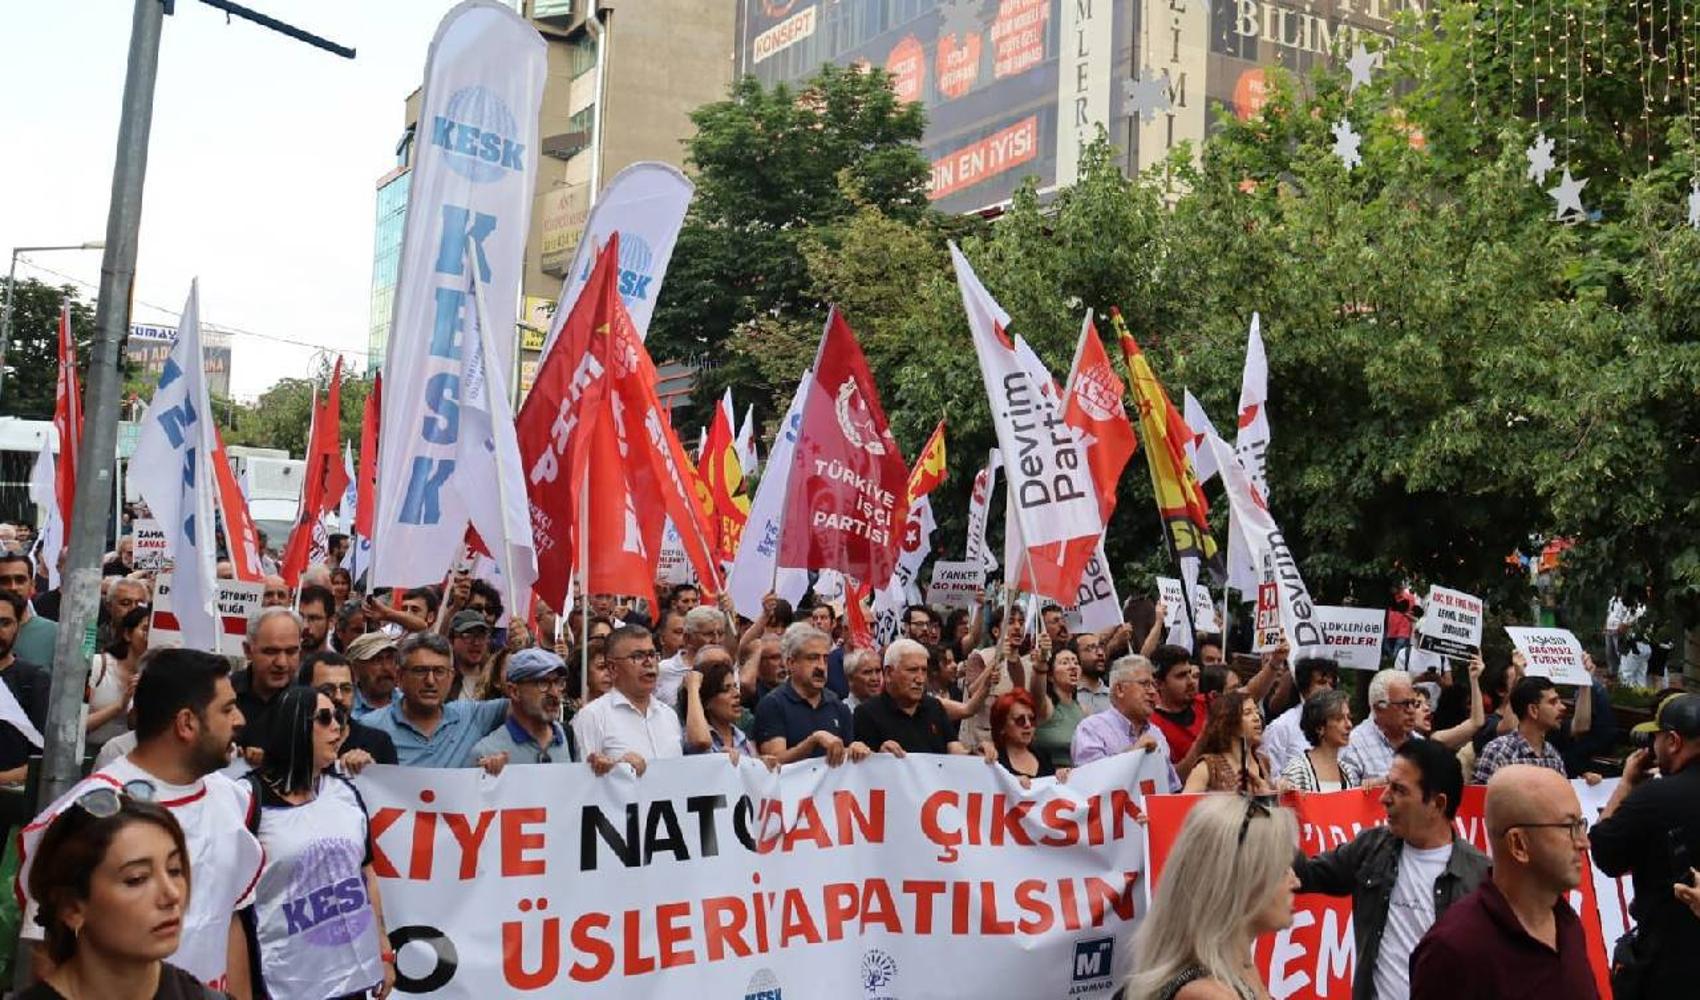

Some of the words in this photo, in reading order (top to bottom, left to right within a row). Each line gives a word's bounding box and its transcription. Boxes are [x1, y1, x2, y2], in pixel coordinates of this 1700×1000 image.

[755, 13, 811, 58] KONSEPT
[430, 115, 526, 171] KESK
[959, 150, 985, 180] EN
[989, 124, 1032, 170] İYİSİ
[397, 204, 497, 525] KESK
[1002, 371, 1051, 509] Devrim
[815, 459, 895, 510] TÜRKİYE
[856, 493, 891, 527] İŞÇİ
[813, 510, 890, 548] PARTİSİ
[932, 582, 949, 590] GO
[920, 779, 1156, 863] ÇIKSIN
[282, 876, 371, 936] KES
